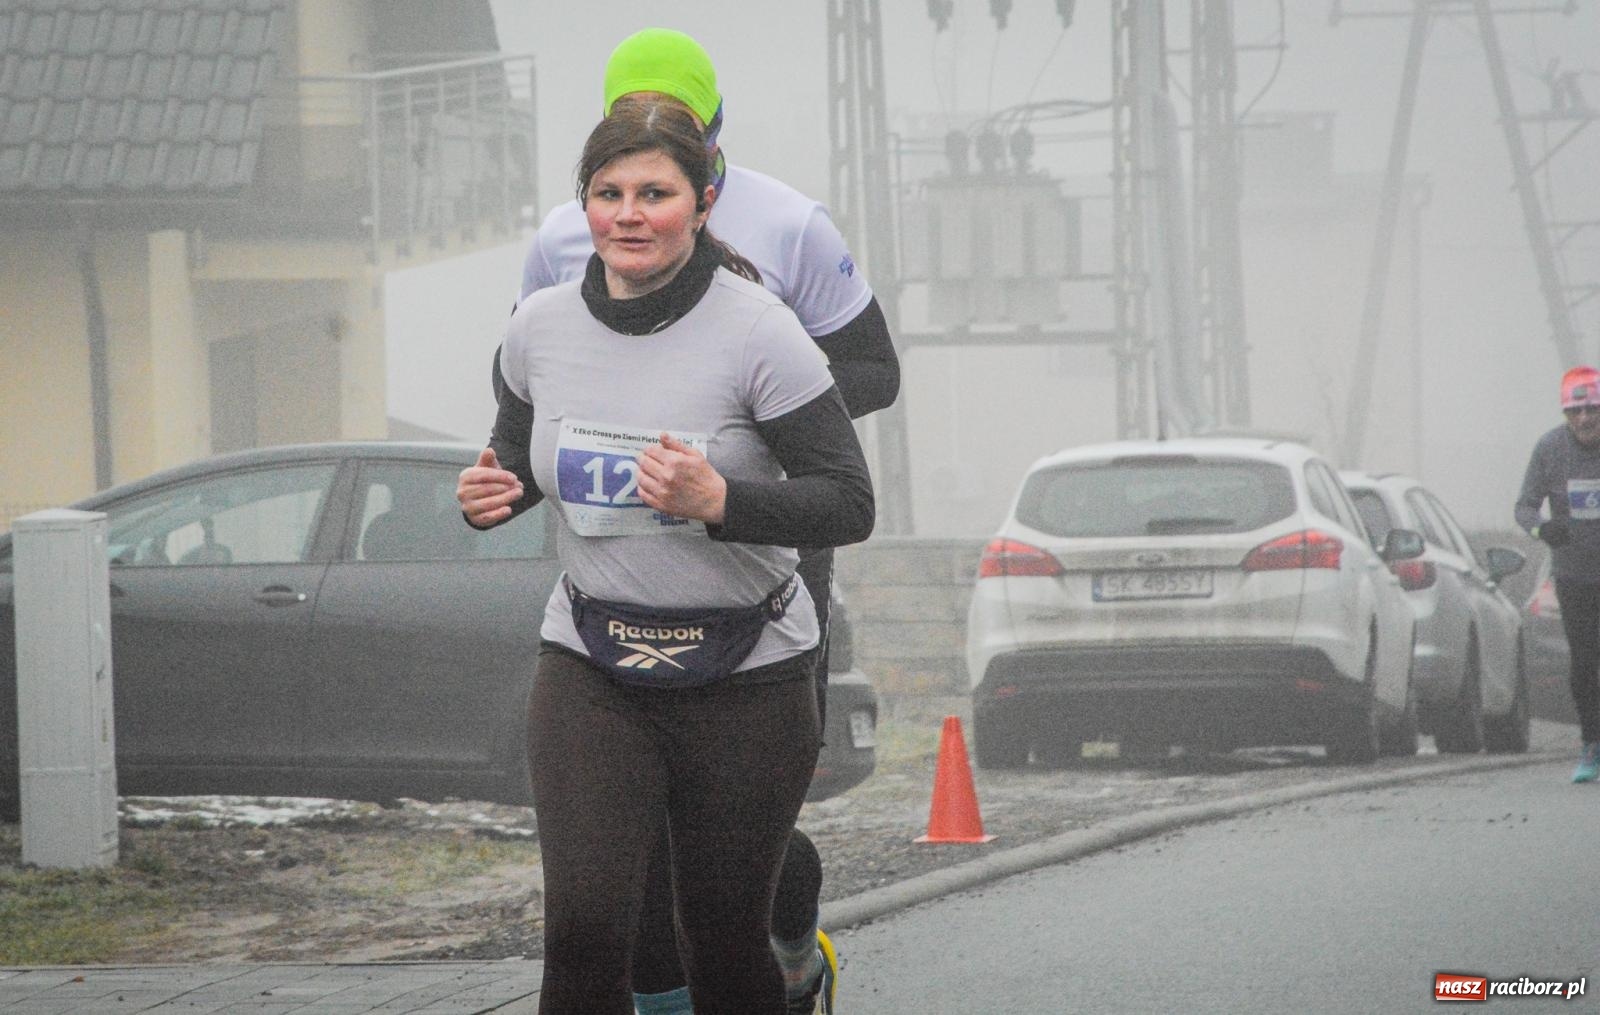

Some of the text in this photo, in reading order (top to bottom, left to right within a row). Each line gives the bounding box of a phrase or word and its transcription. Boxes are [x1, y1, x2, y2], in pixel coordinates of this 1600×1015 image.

[578, 428, 591, 436] Eko
[592, 430, 612, 439] Cross
[613, 432, 622, 441] po
[622, 433, 641, 442] Ziemi
[582, 456, 645, 504] 12
[608, 620, 704, 641] Reebok
